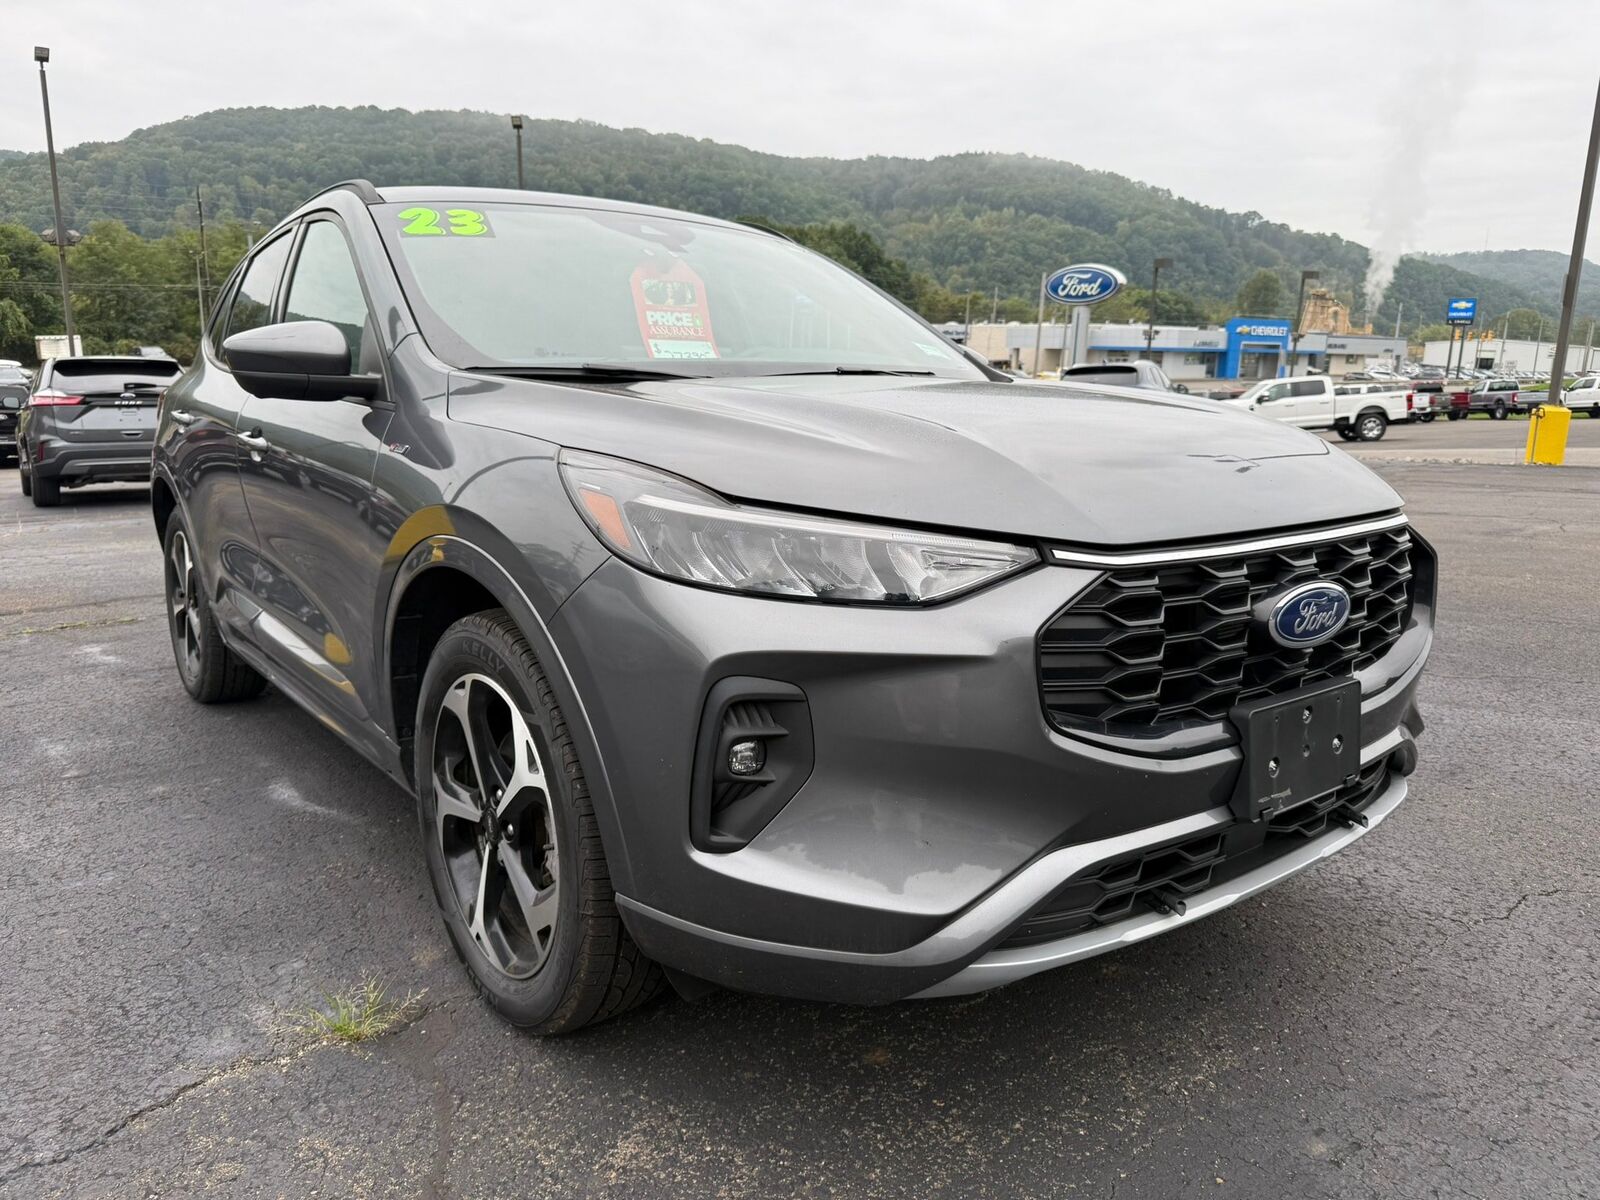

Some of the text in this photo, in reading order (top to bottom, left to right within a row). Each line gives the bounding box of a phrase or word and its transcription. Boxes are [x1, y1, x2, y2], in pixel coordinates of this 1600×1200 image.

[397, 207, 488, 236] 23
[1057, 273, 1103, 297] Ford
[645, 310, 694, 327] PRICE
[649, 325, 706, 337] ASSURANCE
[1250, 325, 1288, 337] CHEVROLET
[1293, 596, 1338, 634] Ford
[462, 639, 505, 673] KELLY
